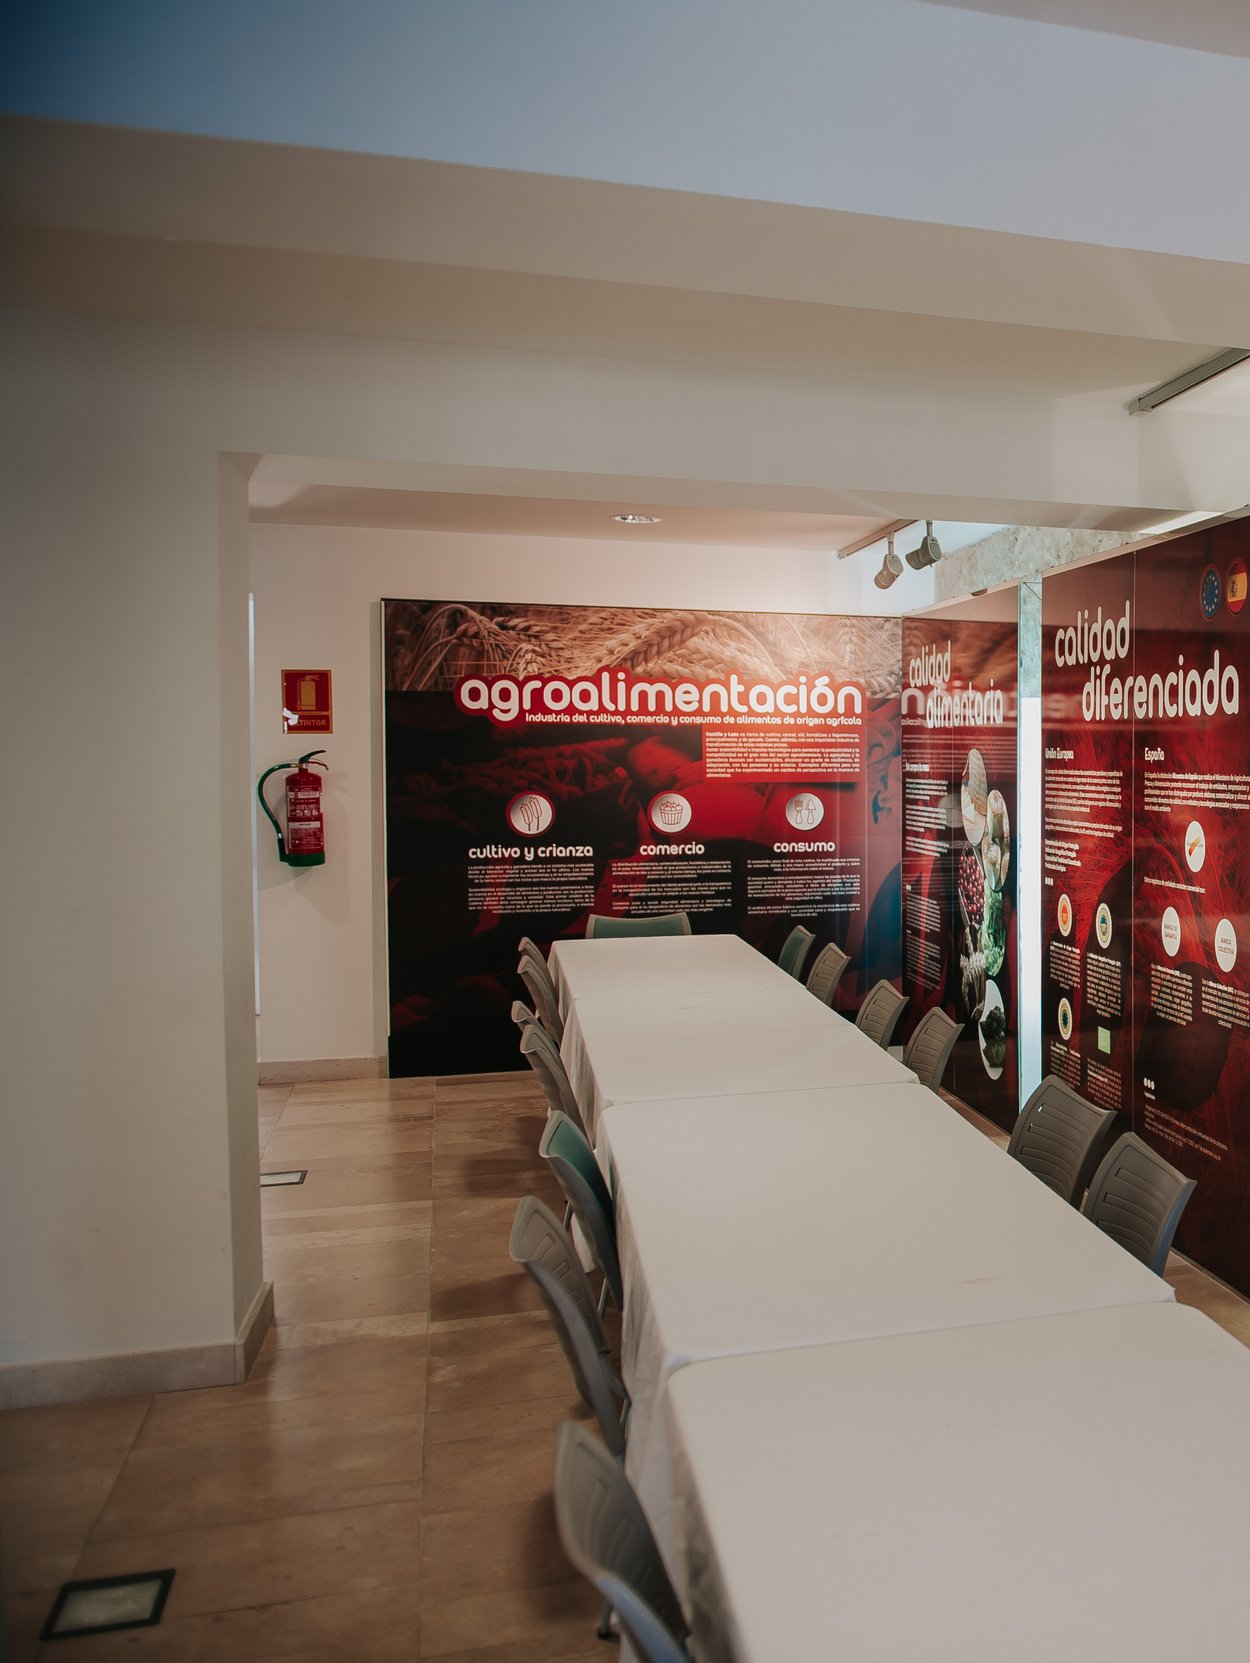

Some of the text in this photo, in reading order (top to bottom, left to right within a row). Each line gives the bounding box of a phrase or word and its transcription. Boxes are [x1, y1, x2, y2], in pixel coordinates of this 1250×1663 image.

[1055, 600, 1130, 667] calidad
[910, 640, 951, 687] calidad
[1082, 649, 1239, 721] diferenciada
[460, 671, 862, 720] agroalimentación
[926, 678, 1003, 728] alimentaria
[526, 713, 862, 727] Industria del cultivo, comercio y consumo de alimentos de origen agrícola
[1045, 748, 1074, 761] Unión Europea
[1144, 748, 1164, 763] España
[468, 844, 593, 861] cultivo y crianza
[640, 841, 704, 855] comercio
[773, 841, 835, 853] consumo
